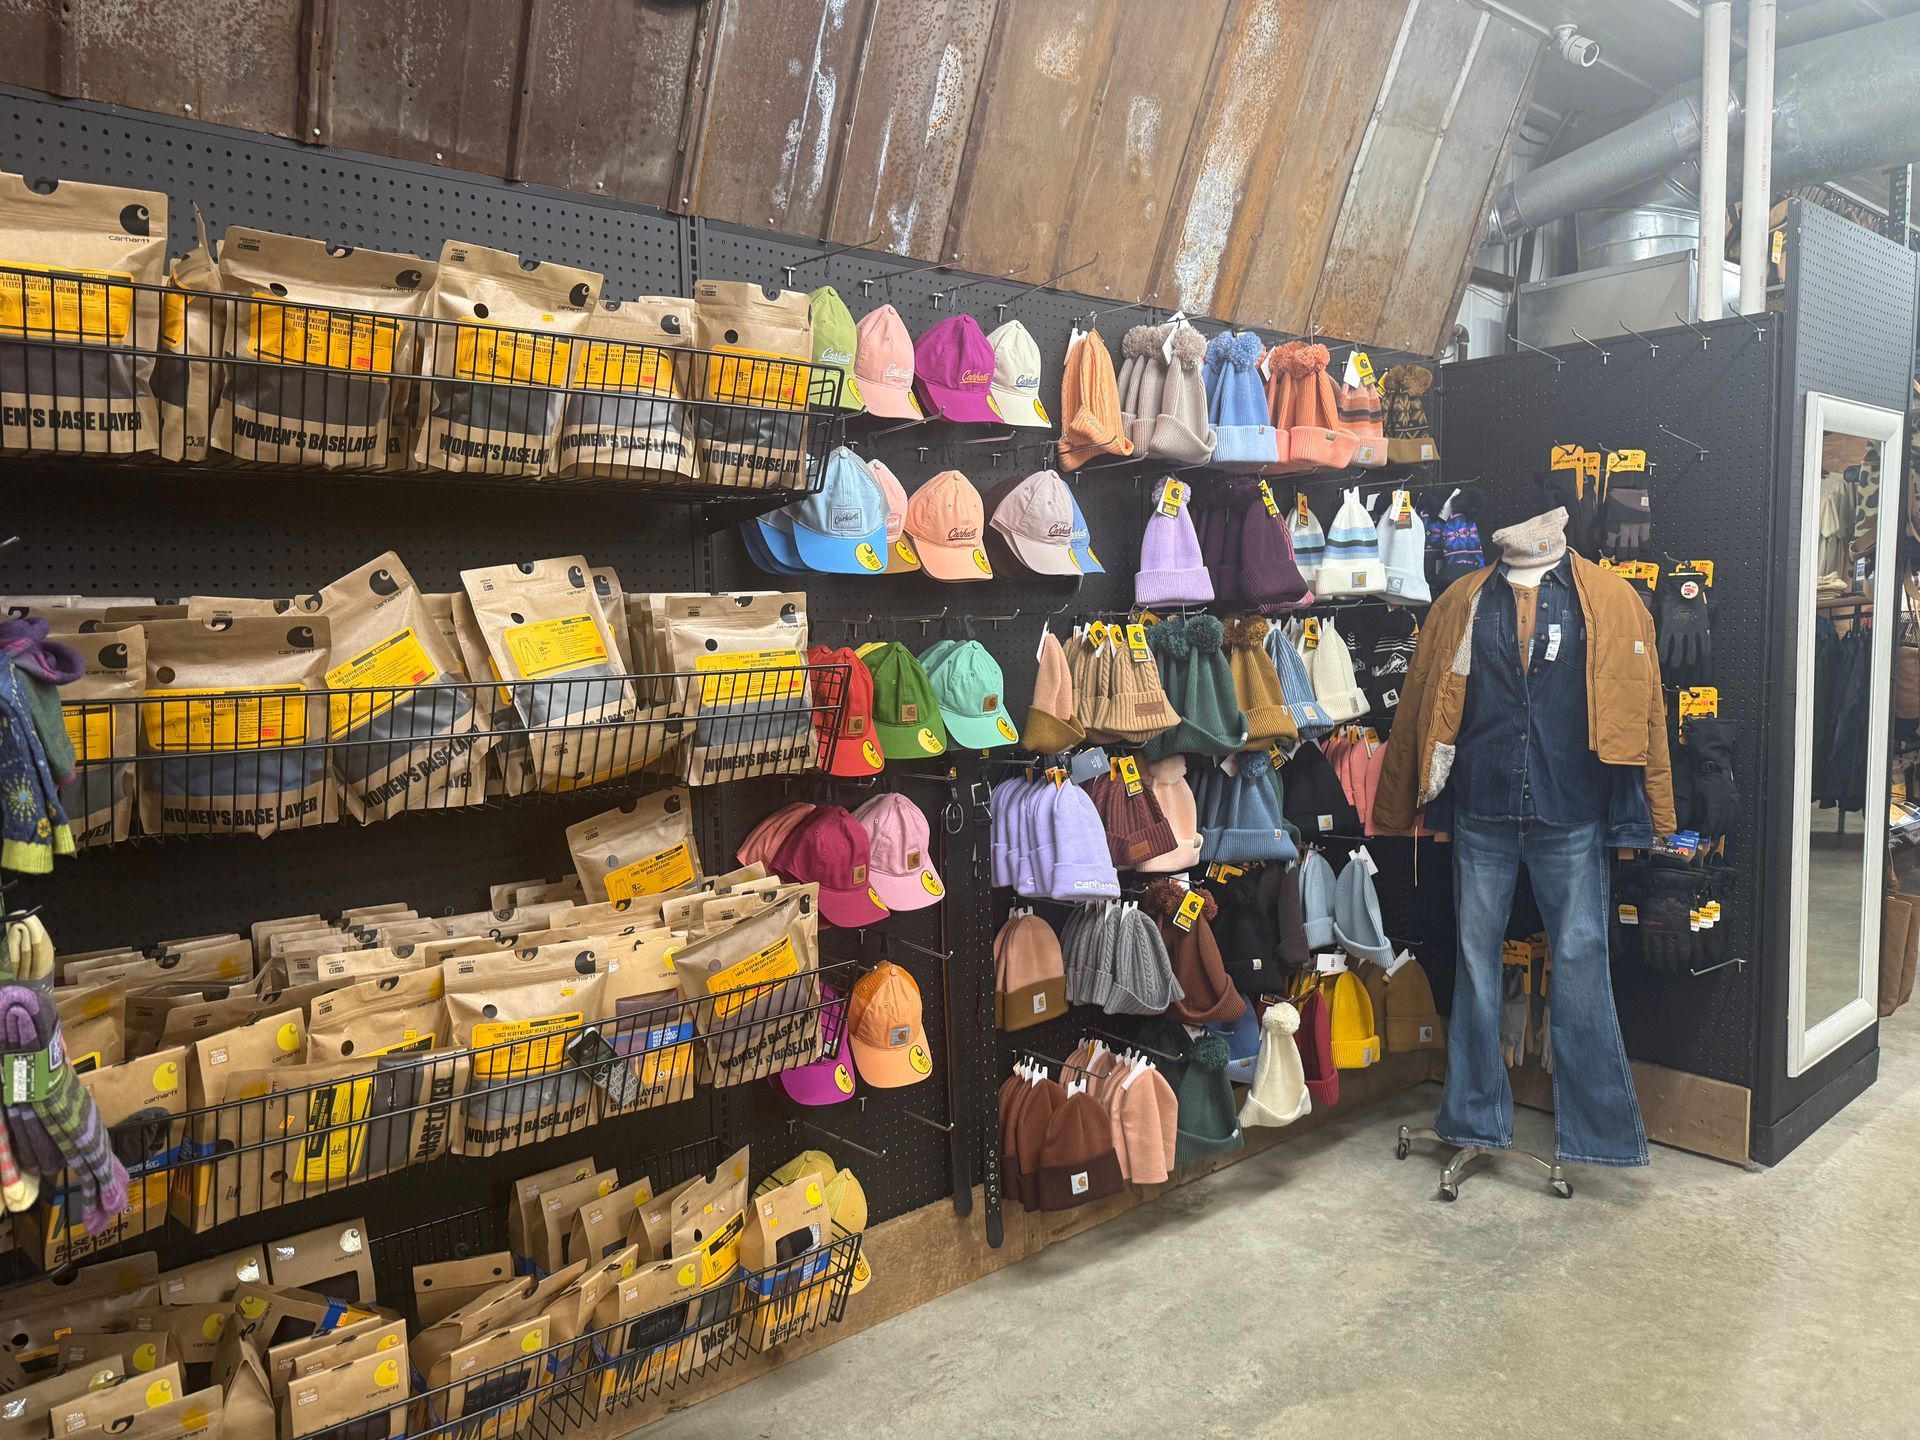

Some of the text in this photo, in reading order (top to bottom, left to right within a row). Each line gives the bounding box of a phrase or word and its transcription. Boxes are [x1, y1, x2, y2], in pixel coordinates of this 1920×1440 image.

[108, 235, 150, 243] carhartt
[3, 406, 142, 432] EN'S BASE LAYER
[234, 416, 307, 449] WOMEN'S
[308, 433, 347, 453] BASE
[561, 434, 687, 458] WOMEN'S BASE LAYER
[439, 433, 500, 461] WOMEN'S
[501, 445, 530, 464] BASE
[702, 447, 754, 469] WOMEN'S
[755, 456, 781, 472] BASE
[949, 527, 978, 539] Carhartt
[373, 590, 403, 610] carhartt
[704, 753, 756, 773] WOMEN'S
[783, 745, 811, 761] LAYER
[358, 766, 422, 809] WOMEN'S
[417, 745, 452, 777] BASE
[163, 796, 318, 827] WOMEN'S BASE LAYER
[1074, 879, 1119, 890] carhartt
[566, 974, 596, 983] carhartt
[720, 1038, 768, 1071] WOMEN'S
[144, 1089, 178, 1105] carhartt
[465, 1102, 587, 1143] WOMEN'S BASE LAYER
[55, 1235, 89, 1254] BASE
